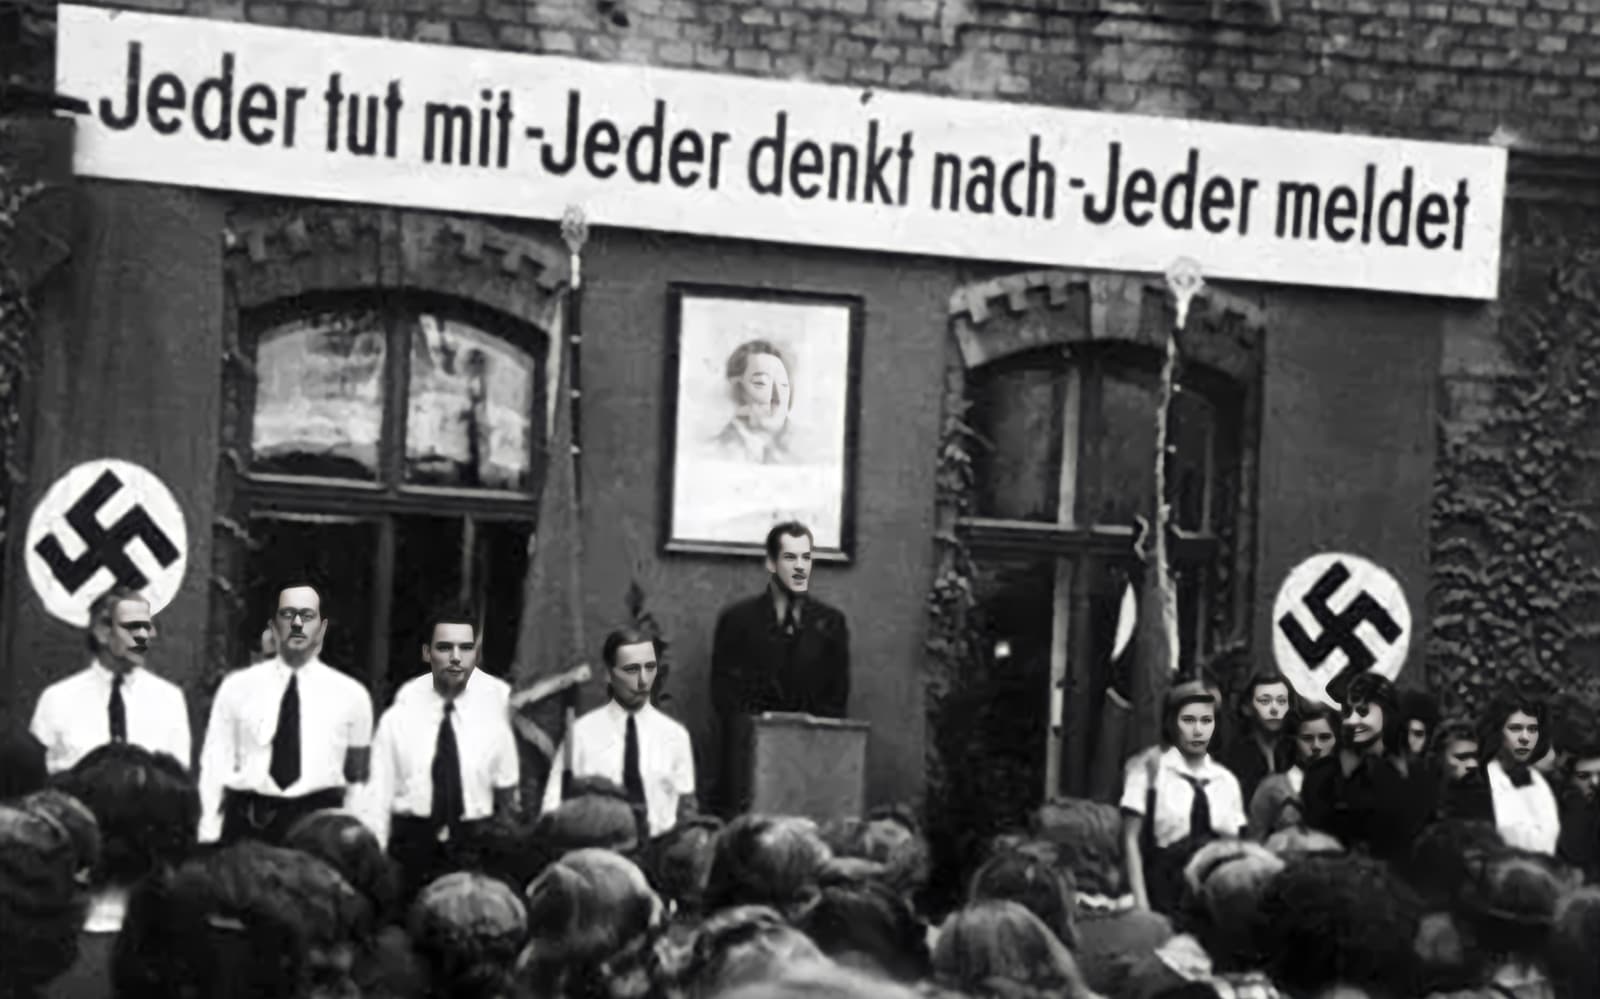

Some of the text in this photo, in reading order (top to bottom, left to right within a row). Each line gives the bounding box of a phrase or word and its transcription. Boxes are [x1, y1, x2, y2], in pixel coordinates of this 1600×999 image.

[99, 41, 307, 149] Jeder
[324, 73, 403, 158] tut
[423, 89, 513, 169] mit
[748, 111, 913, 206] denkt
[931, 135, 1055, 220] nach
[1275, 164, 1470, 251] meldet
